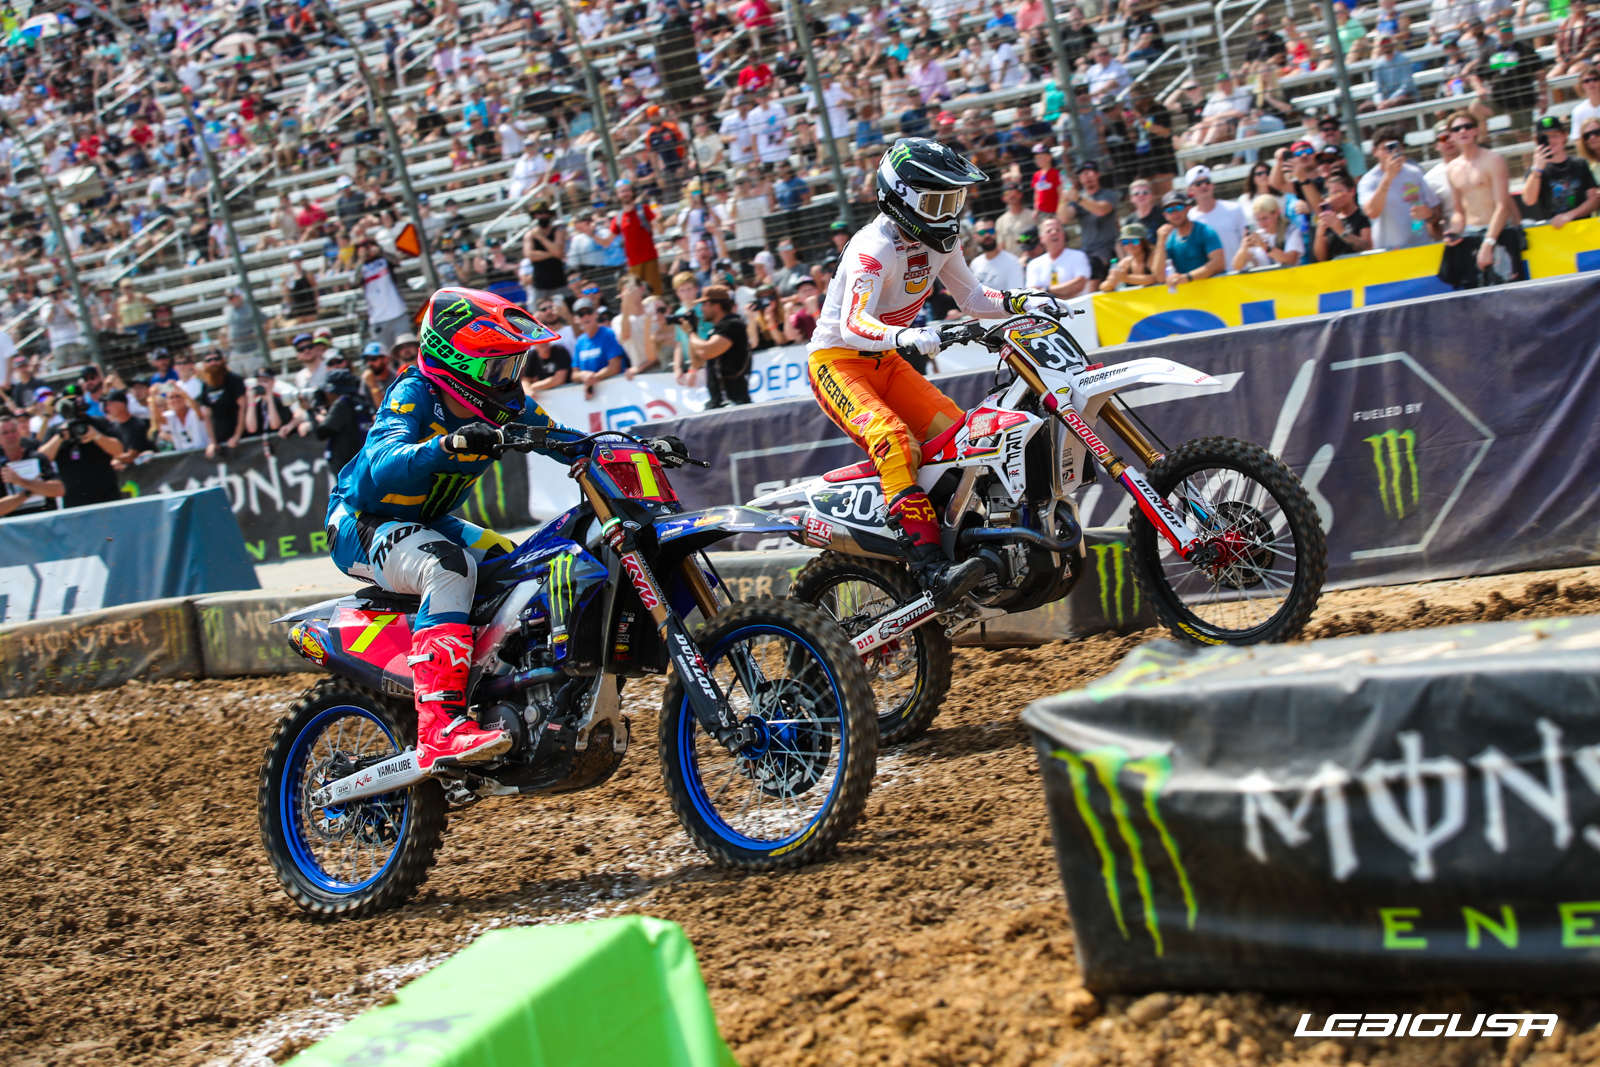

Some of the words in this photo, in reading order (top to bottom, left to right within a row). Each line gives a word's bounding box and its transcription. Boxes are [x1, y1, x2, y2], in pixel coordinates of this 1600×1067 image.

[853, 269, 880, 277] HONDA
[423, 327, 474, 371] 100%
[1031, 333, 1082, 369] 30
[448, 379, 484, 407] MONSTER
[748, 361, 811, 394] DEP
[817, 364, 855, 418] CHERRY
[1353, 403, 1401, 422] FUELED
[1404, 401, 1423, 415] BY
[1005, 430, 1023, 464] CRF
[1062, 412, 1110, 457] SHOWA
[630, 453, 660, 497] 1
[830, 466, 877, 480] HONDA
[830, 485, 878, 520] 30
[1133, 478, 1183, 529] DUNLOP
[620, 554, 659, 610] KYB
[21, 618, 150, 660] MONSTER
[346, 615, 398, 653] 1
[856, 635, 875, 650] DID
[674, 633, 717, 700] DUNLOP
[677, 654, 695, 683] BRAKING
[377, 758, 412, 778] YAMALUBE
